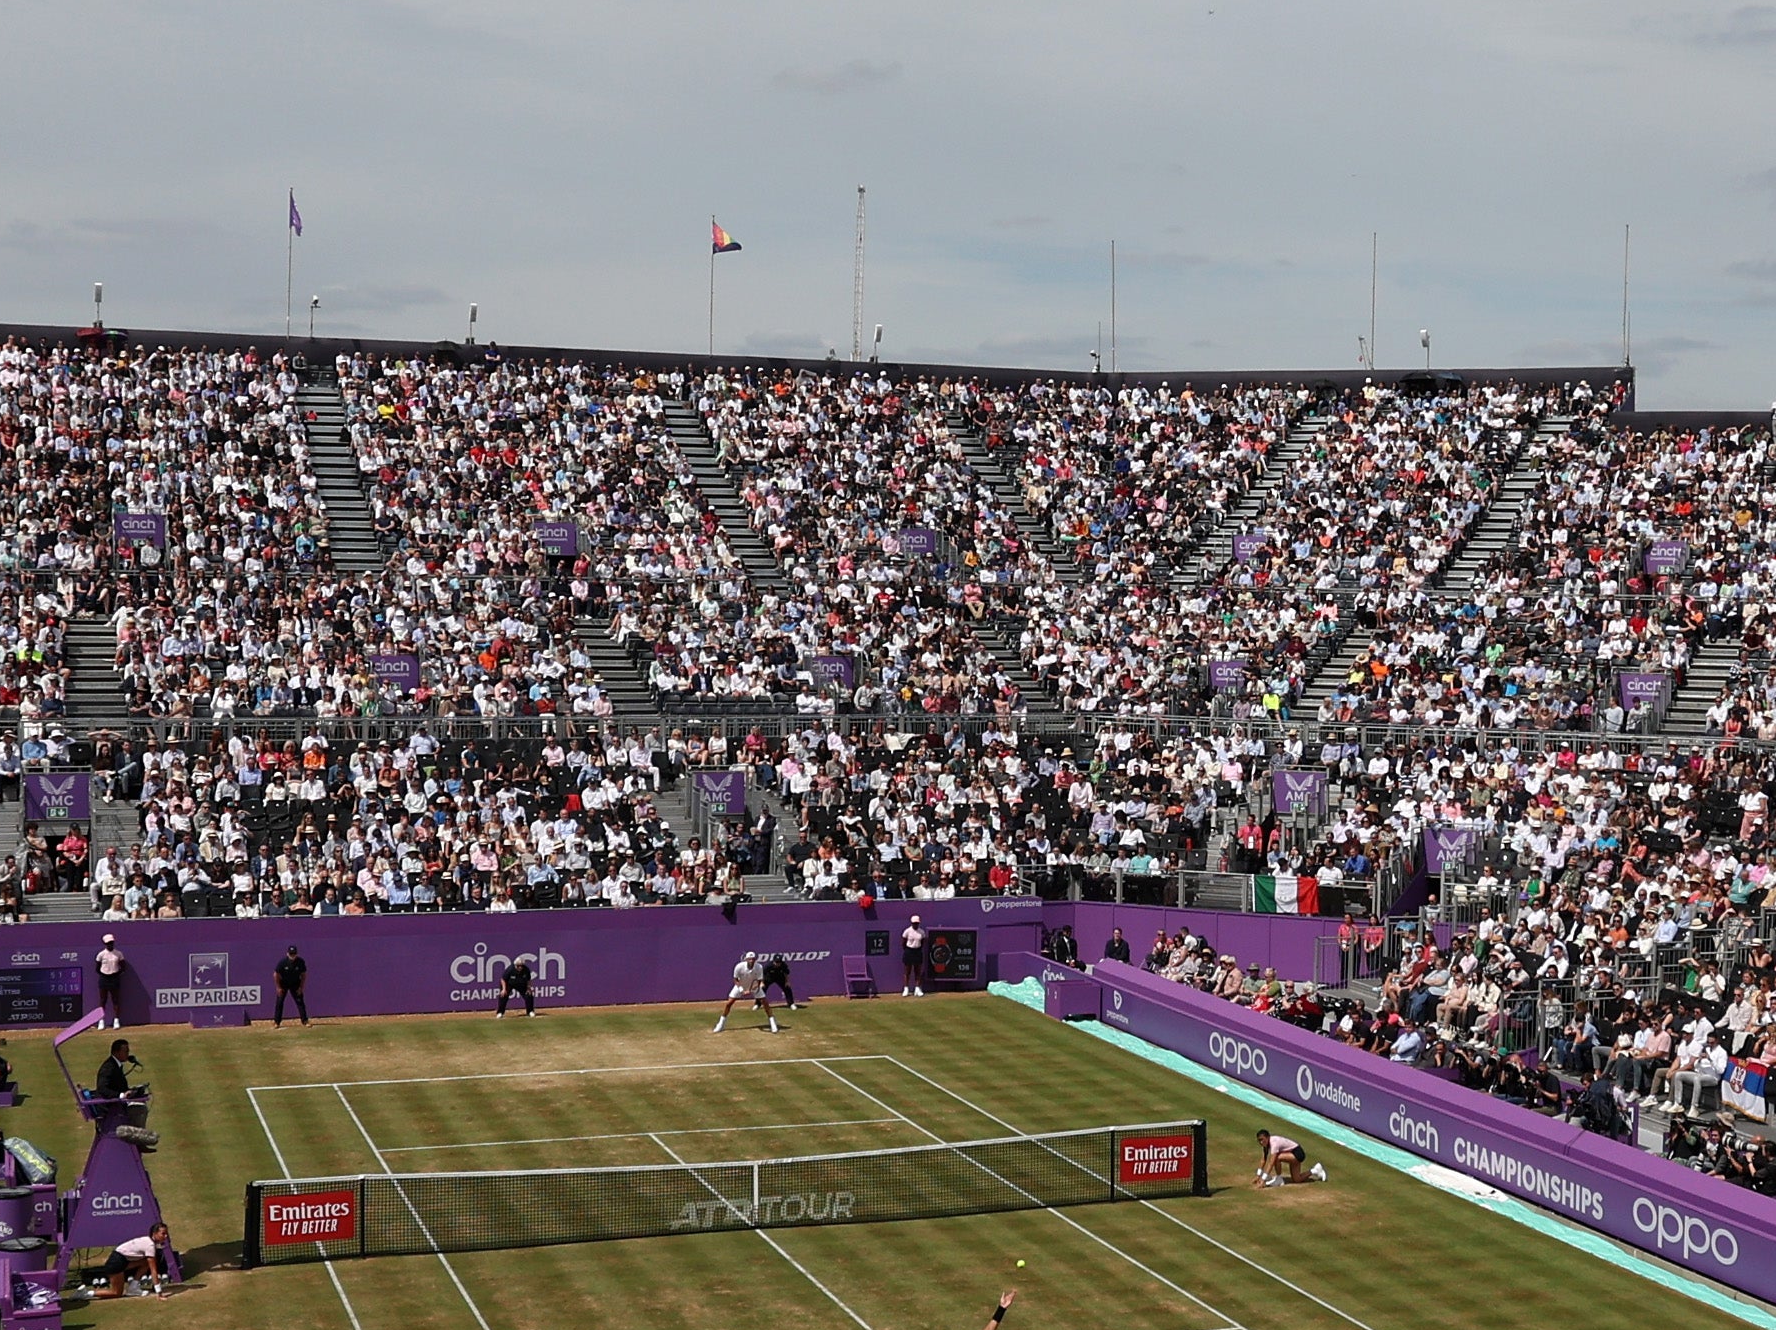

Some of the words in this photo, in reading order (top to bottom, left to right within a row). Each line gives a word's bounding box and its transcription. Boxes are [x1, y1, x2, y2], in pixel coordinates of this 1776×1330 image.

[121, 516, 156, 529] cinch
[536, 525, 568, 537] cinch
[374, 658, 410, 672] cinch
[39, 795, 74, 807] AMC
[703, 792, 732, 802] AMC
[11, 951, 40, 962] cinch
[158, 991, 190, 1006] BNP
[195, 989, 258, 1004] PARIBAS
[450, 986, 566, 1001] CHAMPHIPS
[11, 997, 39, 1008] cinch
[59, 1002, 73, 1014] 12
[1209, 1031, 1267, 1076] oppo
[1313, 1080, 1361, 1112] vodafone
[1123, 1144, 1188, 1162] Emirates
[1132, 1161, 1148, 1175] FLY
[1149, 1160, 1178, 1173] BETTER
[1389, 1104, 1439, 1154] cinch
[1453, 1137, 1604, 1221] CHAMPIONSHIPS
[91, 1191, 142, 1210] cinch
[760, 1191, 856, 1223] TOUR
[91, 1208, 142, 1217] CHAMPIONSHIPS
[268, 1201, 350, 1222] Emirates
[281, 1221, 299, 1236] FLY
[300, 1218, 338, 1235] BETTER
[1632, 1197, 1739, 1266] oppo
